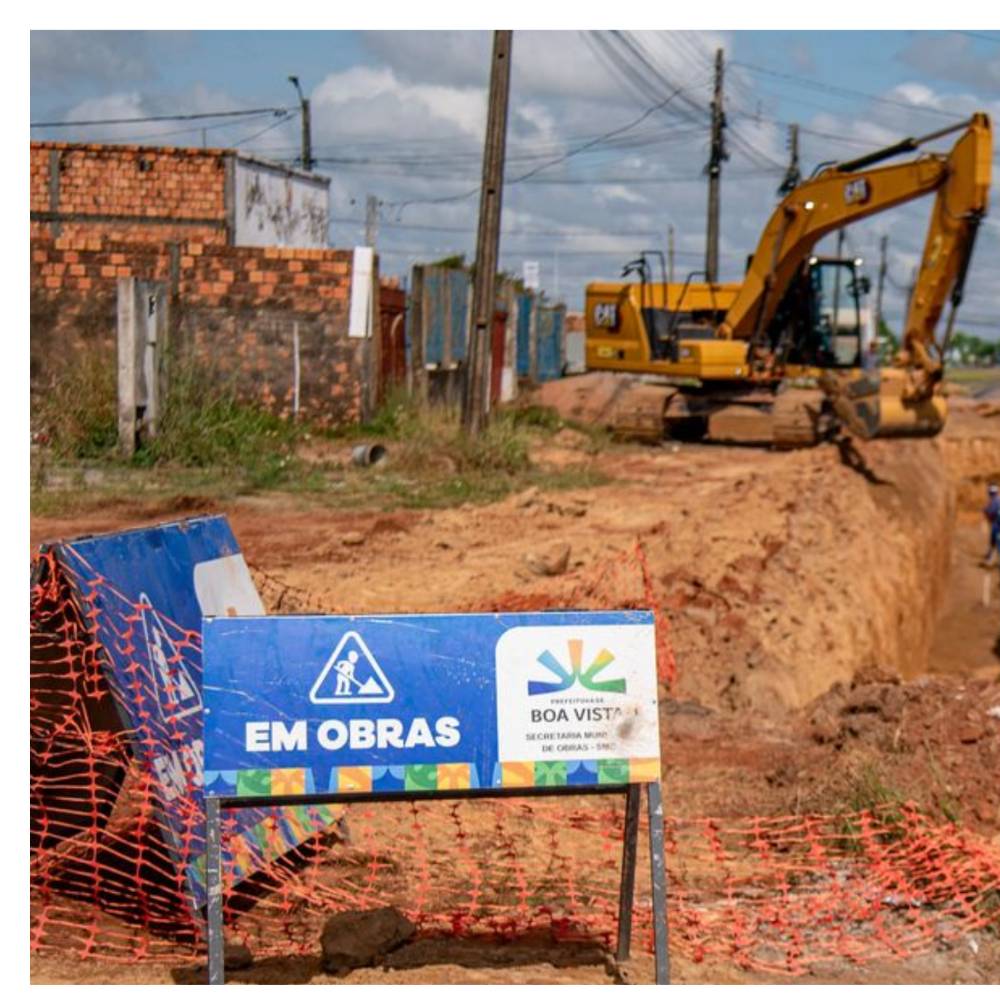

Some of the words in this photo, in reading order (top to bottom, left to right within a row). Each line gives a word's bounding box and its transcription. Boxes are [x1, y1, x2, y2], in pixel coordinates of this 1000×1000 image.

[531, 708, 569, 723] BOA
[574, 707, 622, 722] VISTA
[245, 720, 308, 751] EM
[317, 716, 461, 750] OBRAS
[526, 731, 582, 741] SECRETARIA
[556, 744, 589, 752] OBRAS
